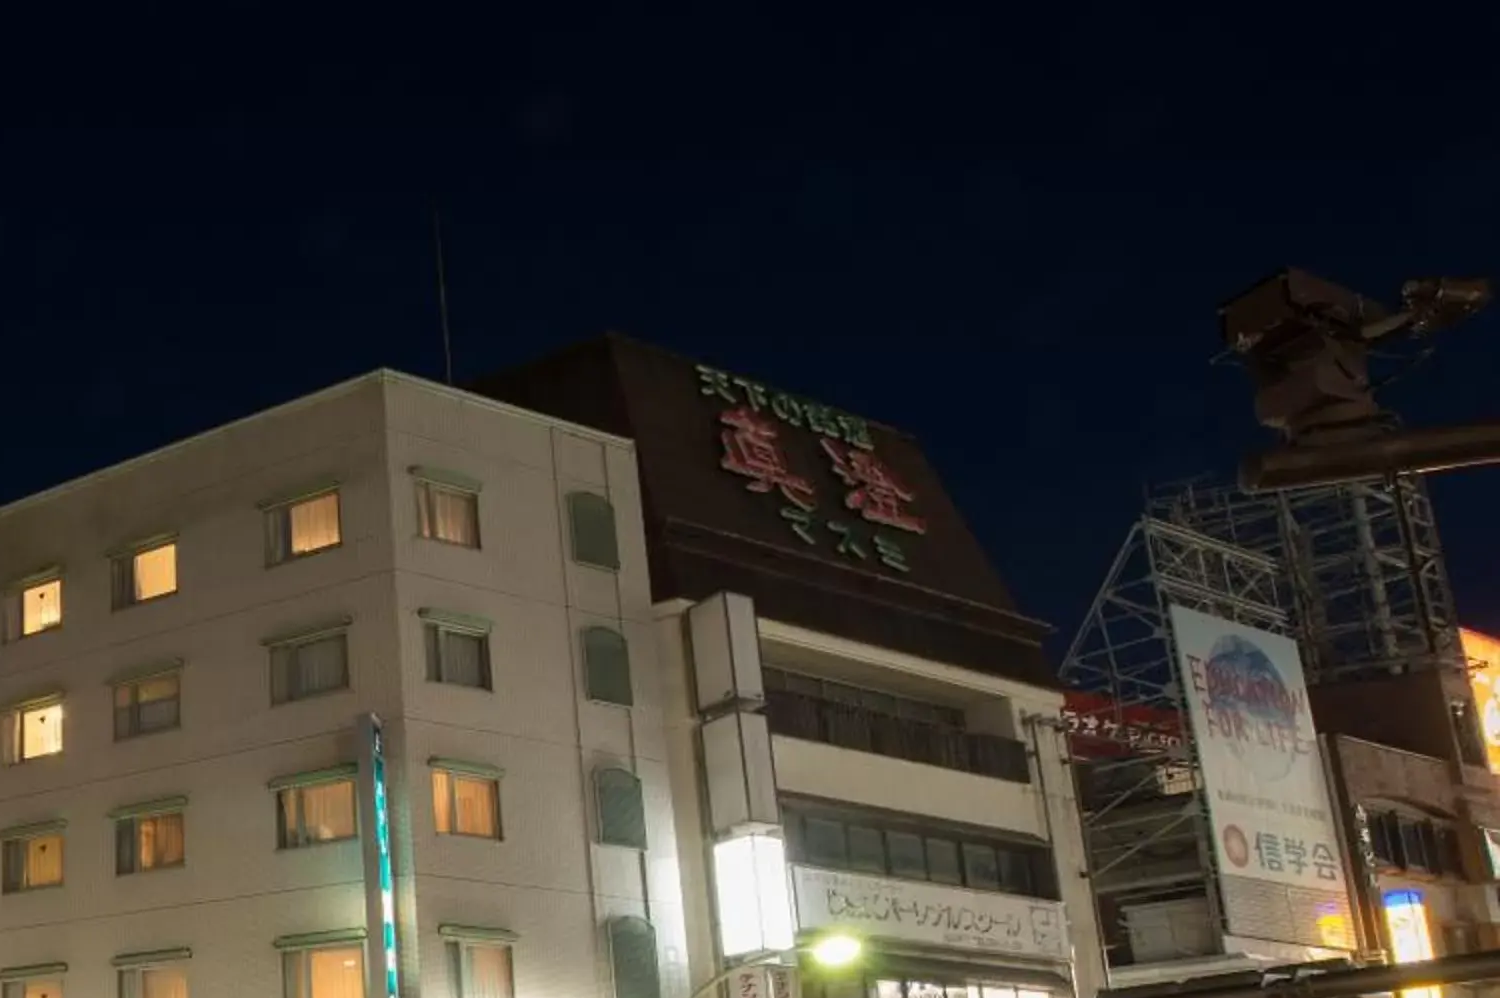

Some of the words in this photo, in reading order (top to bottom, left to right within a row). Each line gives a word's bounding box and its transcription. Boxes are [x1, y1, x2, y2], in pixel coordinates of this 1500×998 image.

[779, 505, 911, 572] マスミ
[1204, 703, 1251, 744] FOR
[1253, 716, 1313, 756] LIFE
[1254, 829, 1338, 882] 信学会
